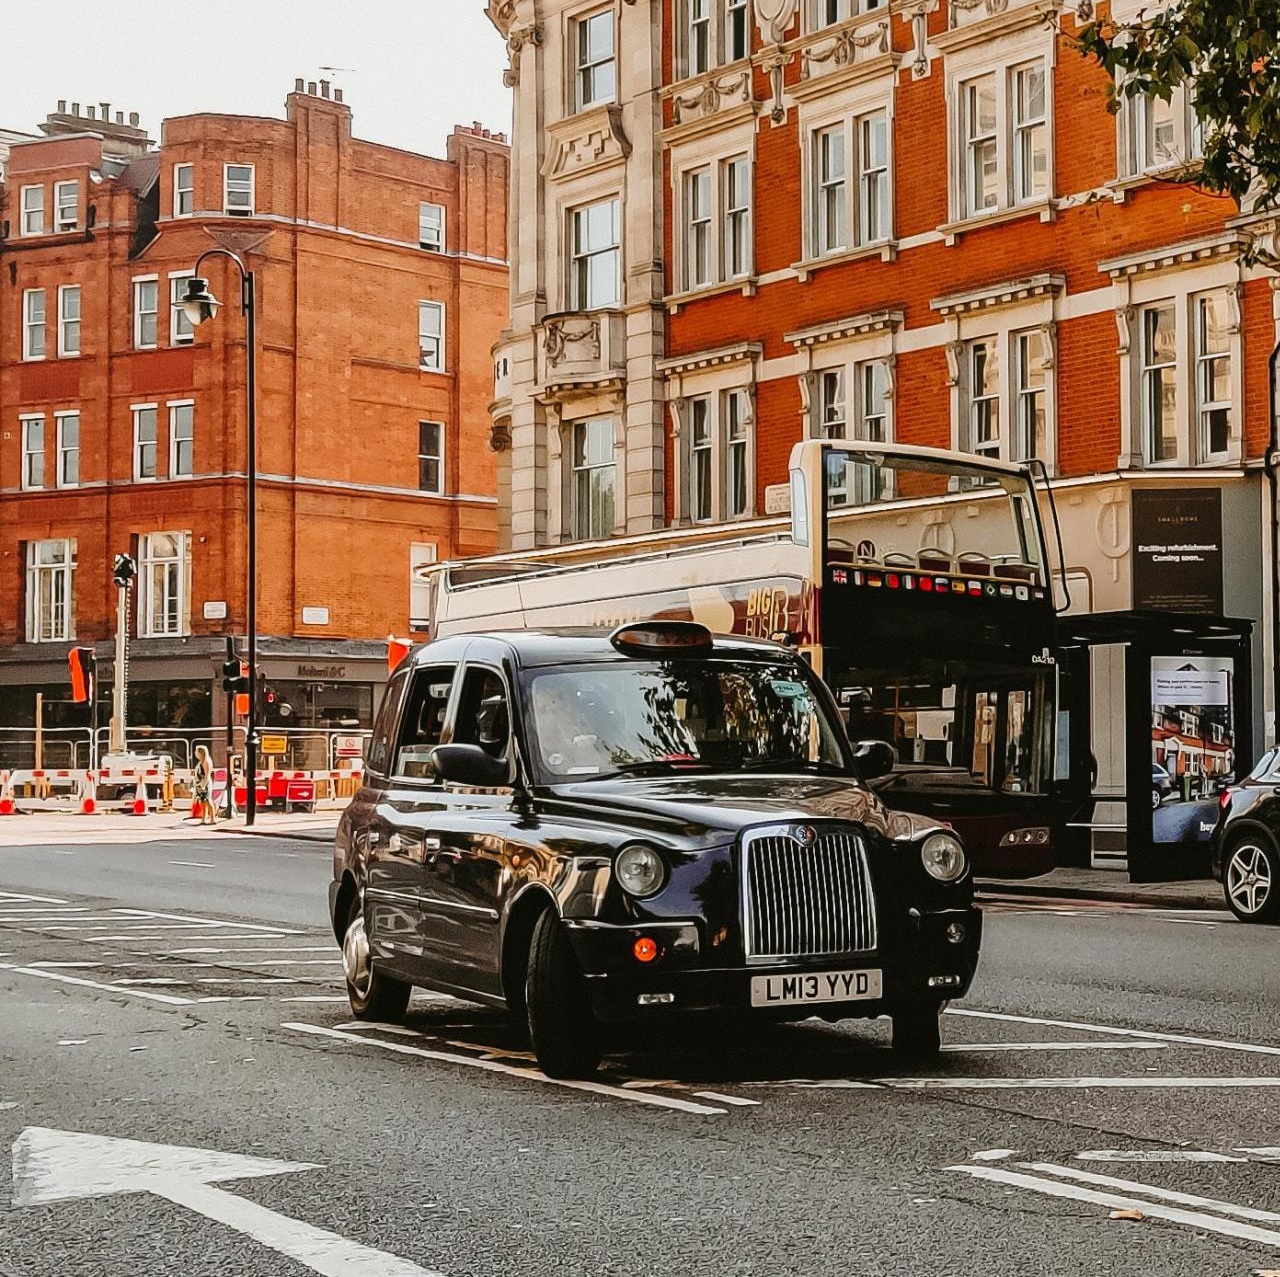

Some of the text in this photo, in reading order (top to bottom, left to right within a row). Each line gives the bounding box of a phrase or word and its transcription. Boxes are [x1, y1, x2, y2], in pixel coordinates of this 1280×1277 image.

[746, 587, 771, 617] BIG
[745, 616, 769, 640] BUS
[766, 973, 869, 1001] LM13 YYD
